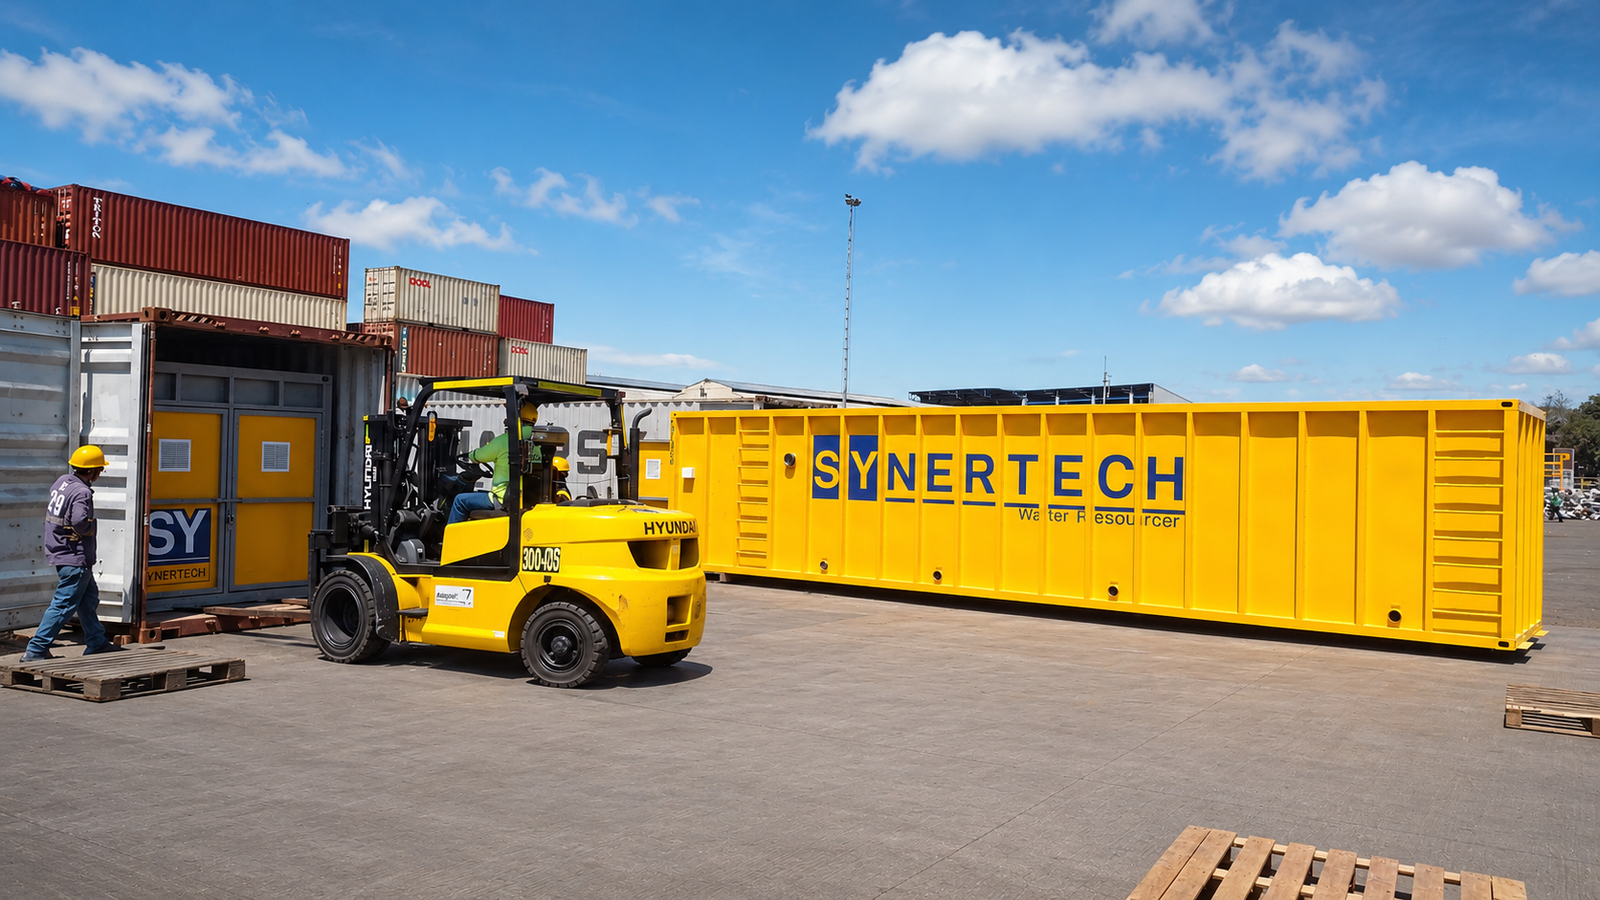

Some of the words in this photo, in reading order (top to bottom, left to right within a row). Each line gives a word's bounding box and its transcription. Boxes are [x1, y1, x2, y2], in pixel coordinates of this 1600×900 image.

[813, 449, 1184, 501] SYNERTECH
[47, 489, 66, 516] 29
[1018, 507, 1069, 523] Water
[148, 509, 208, 556] SY
[147, 567, 206, 581] YNERTECH
